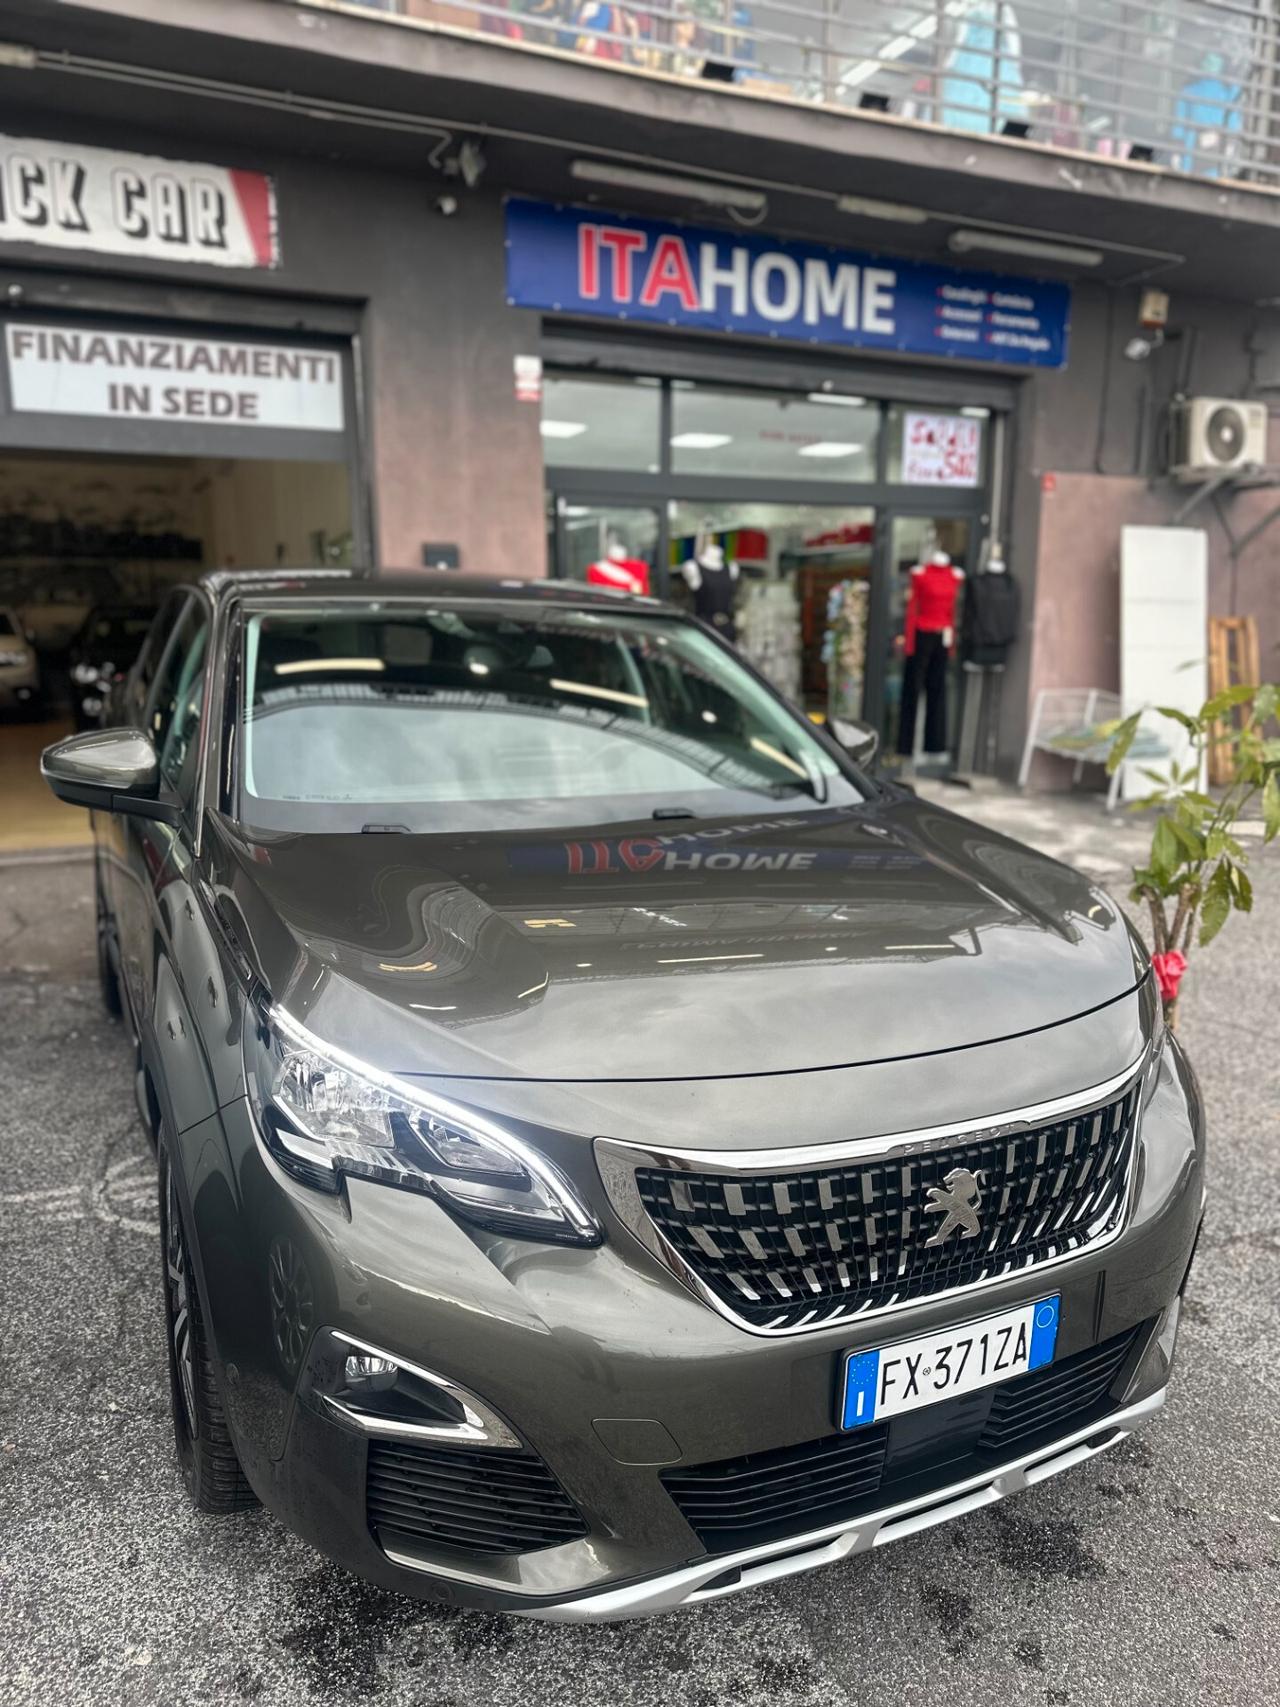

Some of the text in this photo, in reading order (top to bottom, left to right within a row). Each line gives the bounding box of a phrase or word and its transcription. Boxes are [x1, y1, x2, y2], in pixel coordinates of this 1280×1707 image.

[0, 154, 229, 249] CK CAR
[11, 330, 336, 383] FINANZIAMENTI
[108, 383, 259, 419] IN SEDE
